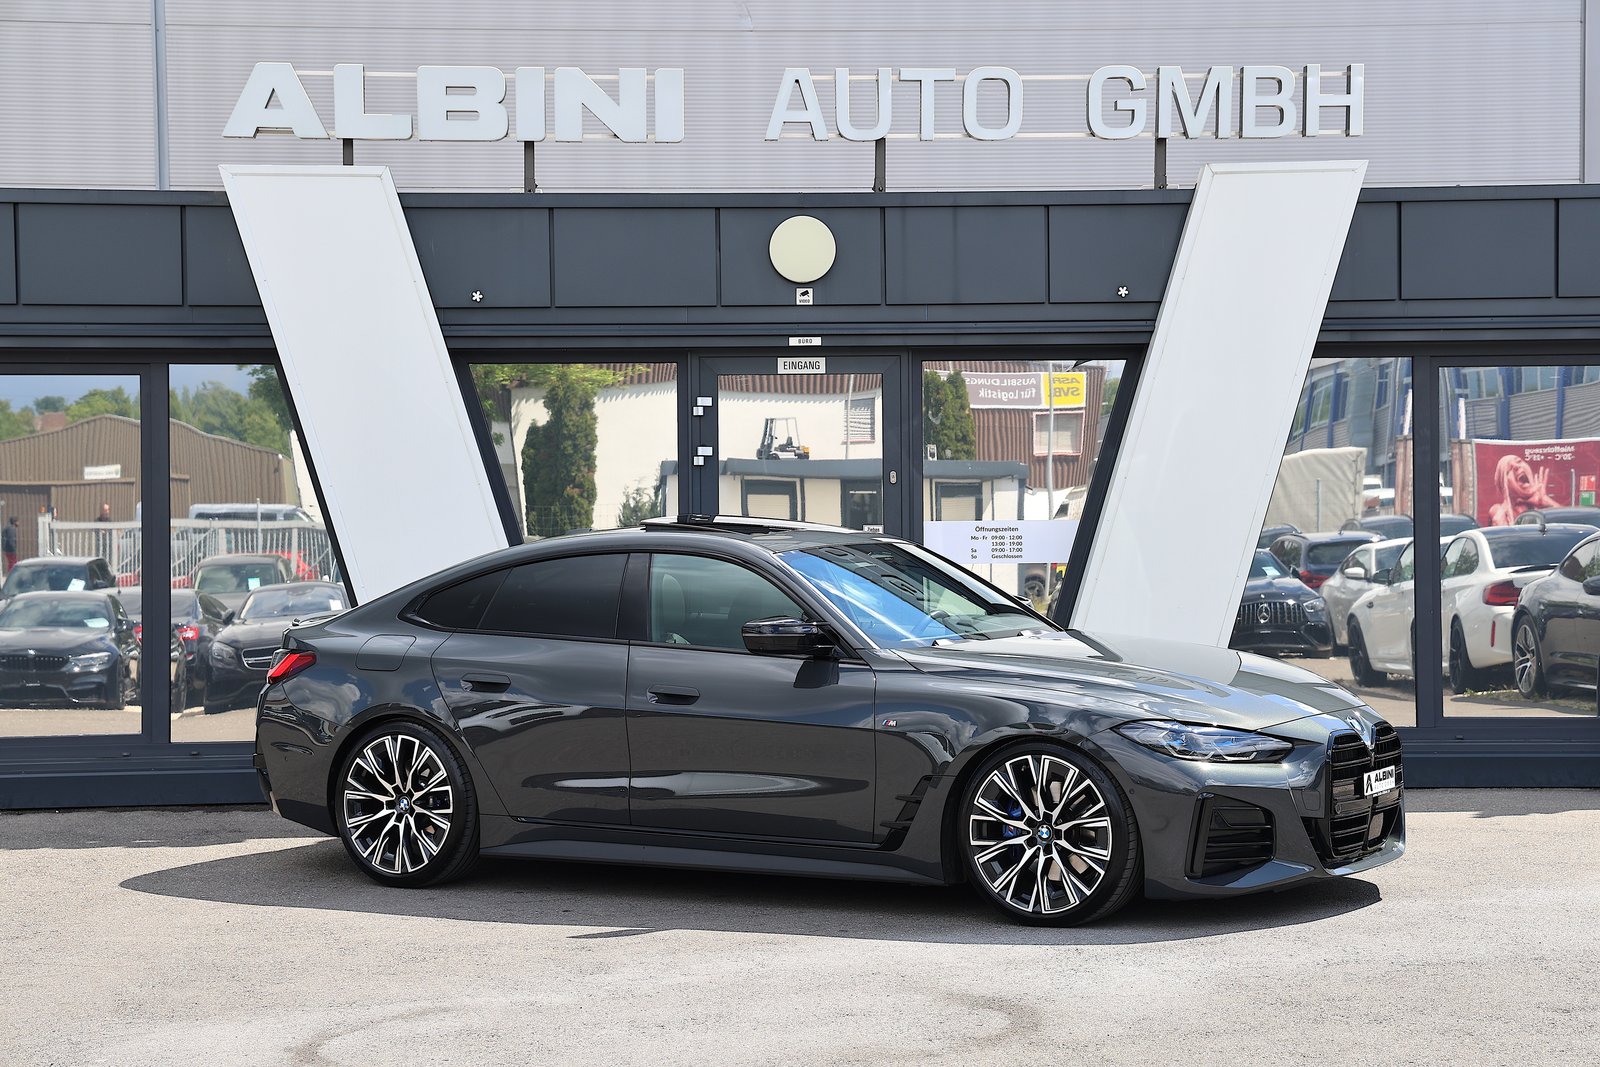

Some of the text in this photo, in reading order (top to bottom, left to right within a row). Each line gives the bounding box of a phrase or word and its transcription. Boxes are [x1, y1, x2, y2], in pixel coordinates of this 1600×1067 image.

[221, 61, 1365, 143] ALBINI AUTO GMBH
[783, 360, 821, 370] EINGANG
[1375, 769, 1394, 783] ALBINI
